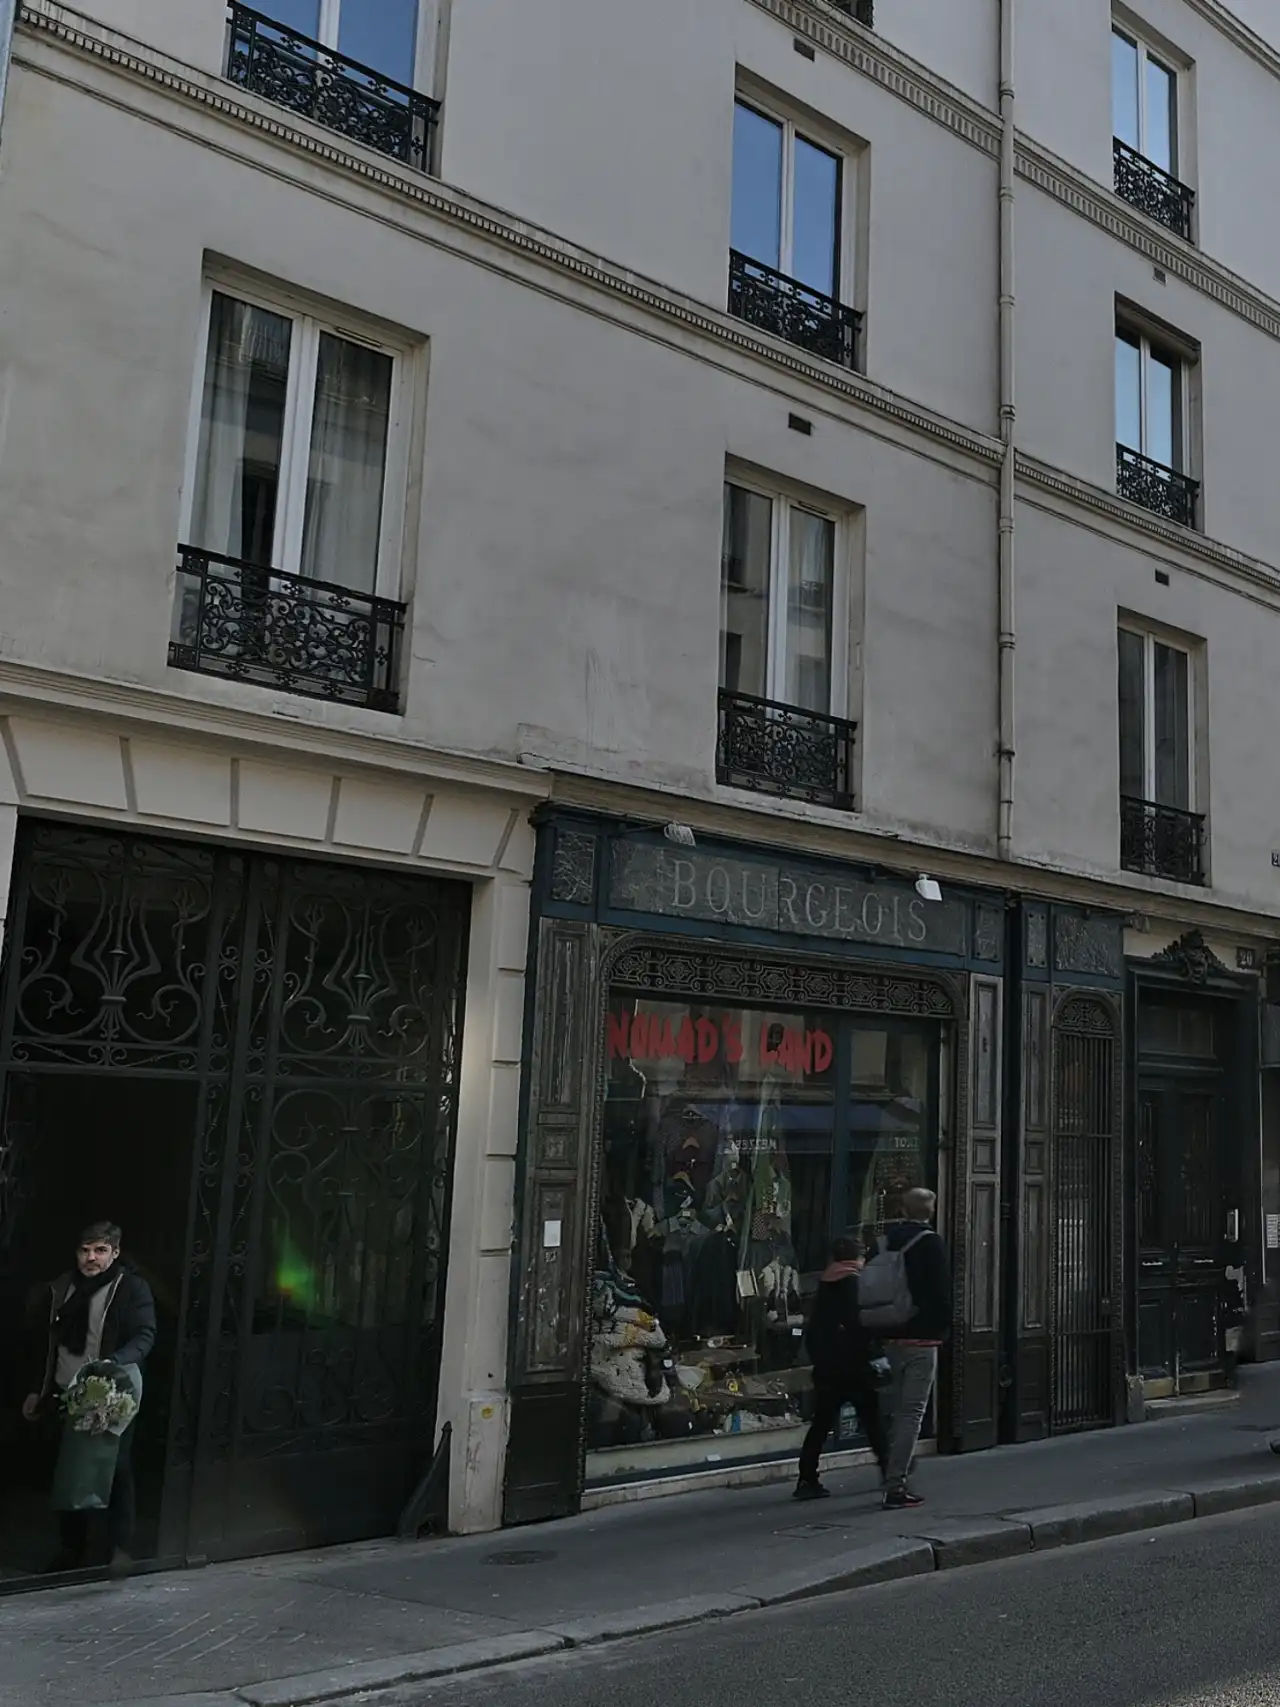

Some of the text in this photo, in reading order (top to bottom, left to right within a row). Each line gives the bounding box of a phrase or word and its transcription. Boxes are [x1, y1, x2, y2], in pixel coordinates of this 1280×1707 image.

[670, 858, 926, 942] BOURGEOIS
[1239, 950, 1253, 966] 20
[607, 1011, 834, 1075] NOMAD'S LAND
